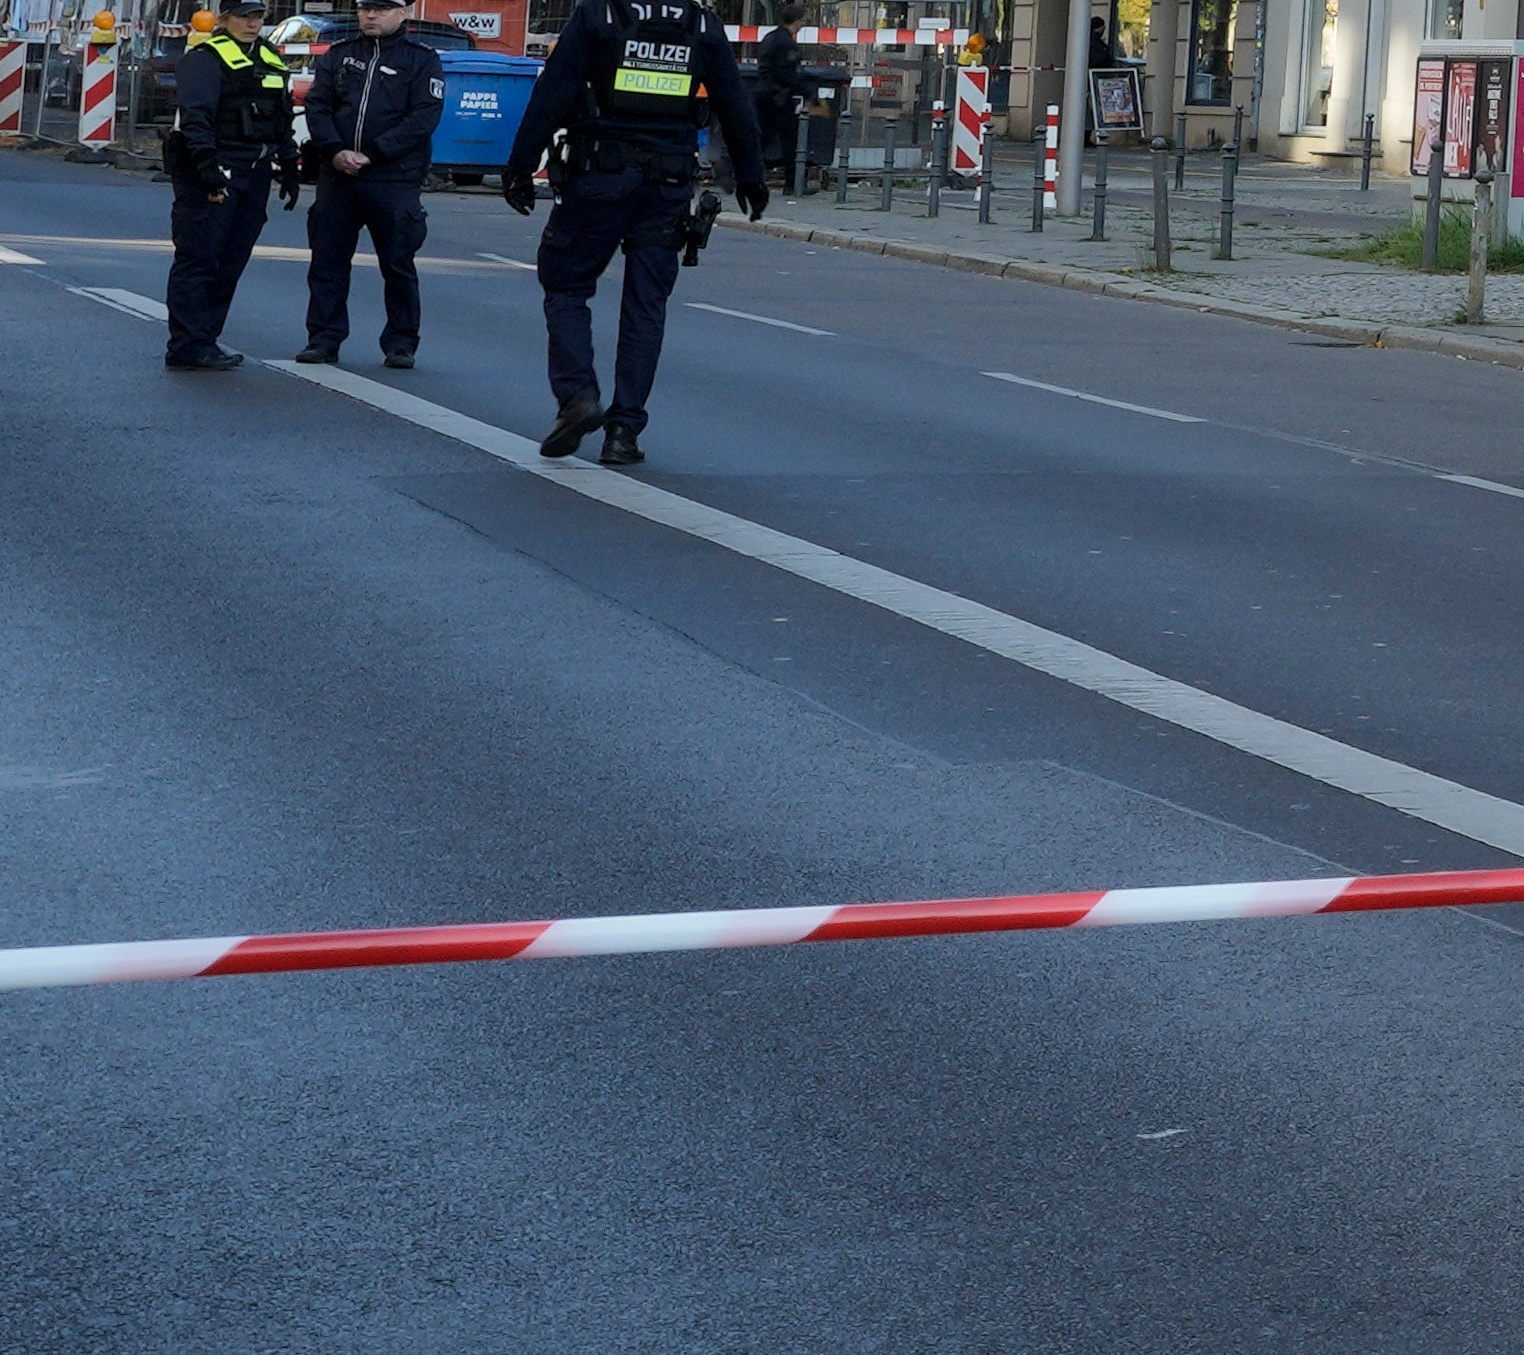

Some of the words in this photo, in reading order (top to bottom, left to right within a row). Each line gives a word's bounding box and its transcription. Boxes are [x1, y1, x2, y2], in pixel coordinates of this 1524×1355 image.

[624, 39, 691, 64] POLIZEI
[623, 72, 684, 92] POLIZEI
[463, 91, 498, 101] PAPPE
[460, 100, 499, 110] PAPIER
